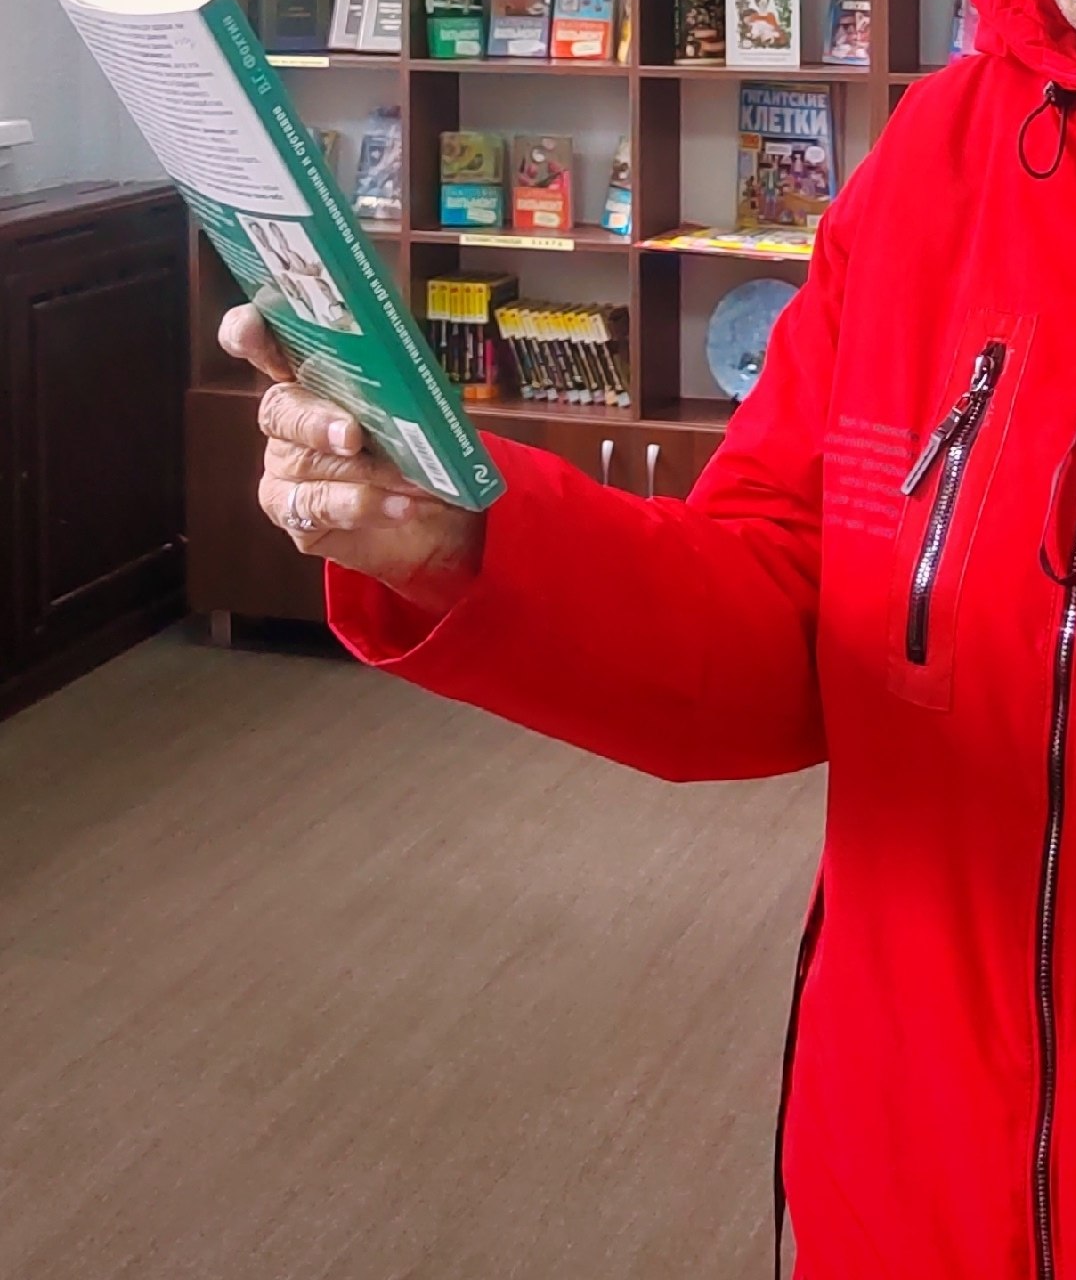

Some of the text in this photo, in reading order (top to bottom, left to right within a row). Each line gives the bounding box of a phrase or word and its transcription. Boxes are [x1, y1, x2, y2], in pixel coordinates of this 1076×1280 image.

[221, 13, 257, 69] Фохтин
[742, 89, 827, 108] ГИГАНТСКИЕ
[742, 105, 828, 135] КЛЕТКИ
[300, 155, 312, 167] и
[305, 164, 355, 244] позвоночника
[350, 241, 376, 280] мышц
[368, 277, 390, 302] для
[381, 299, 423, 365] гимнастика
[416, 361, 475, 458] Биомеханическая
